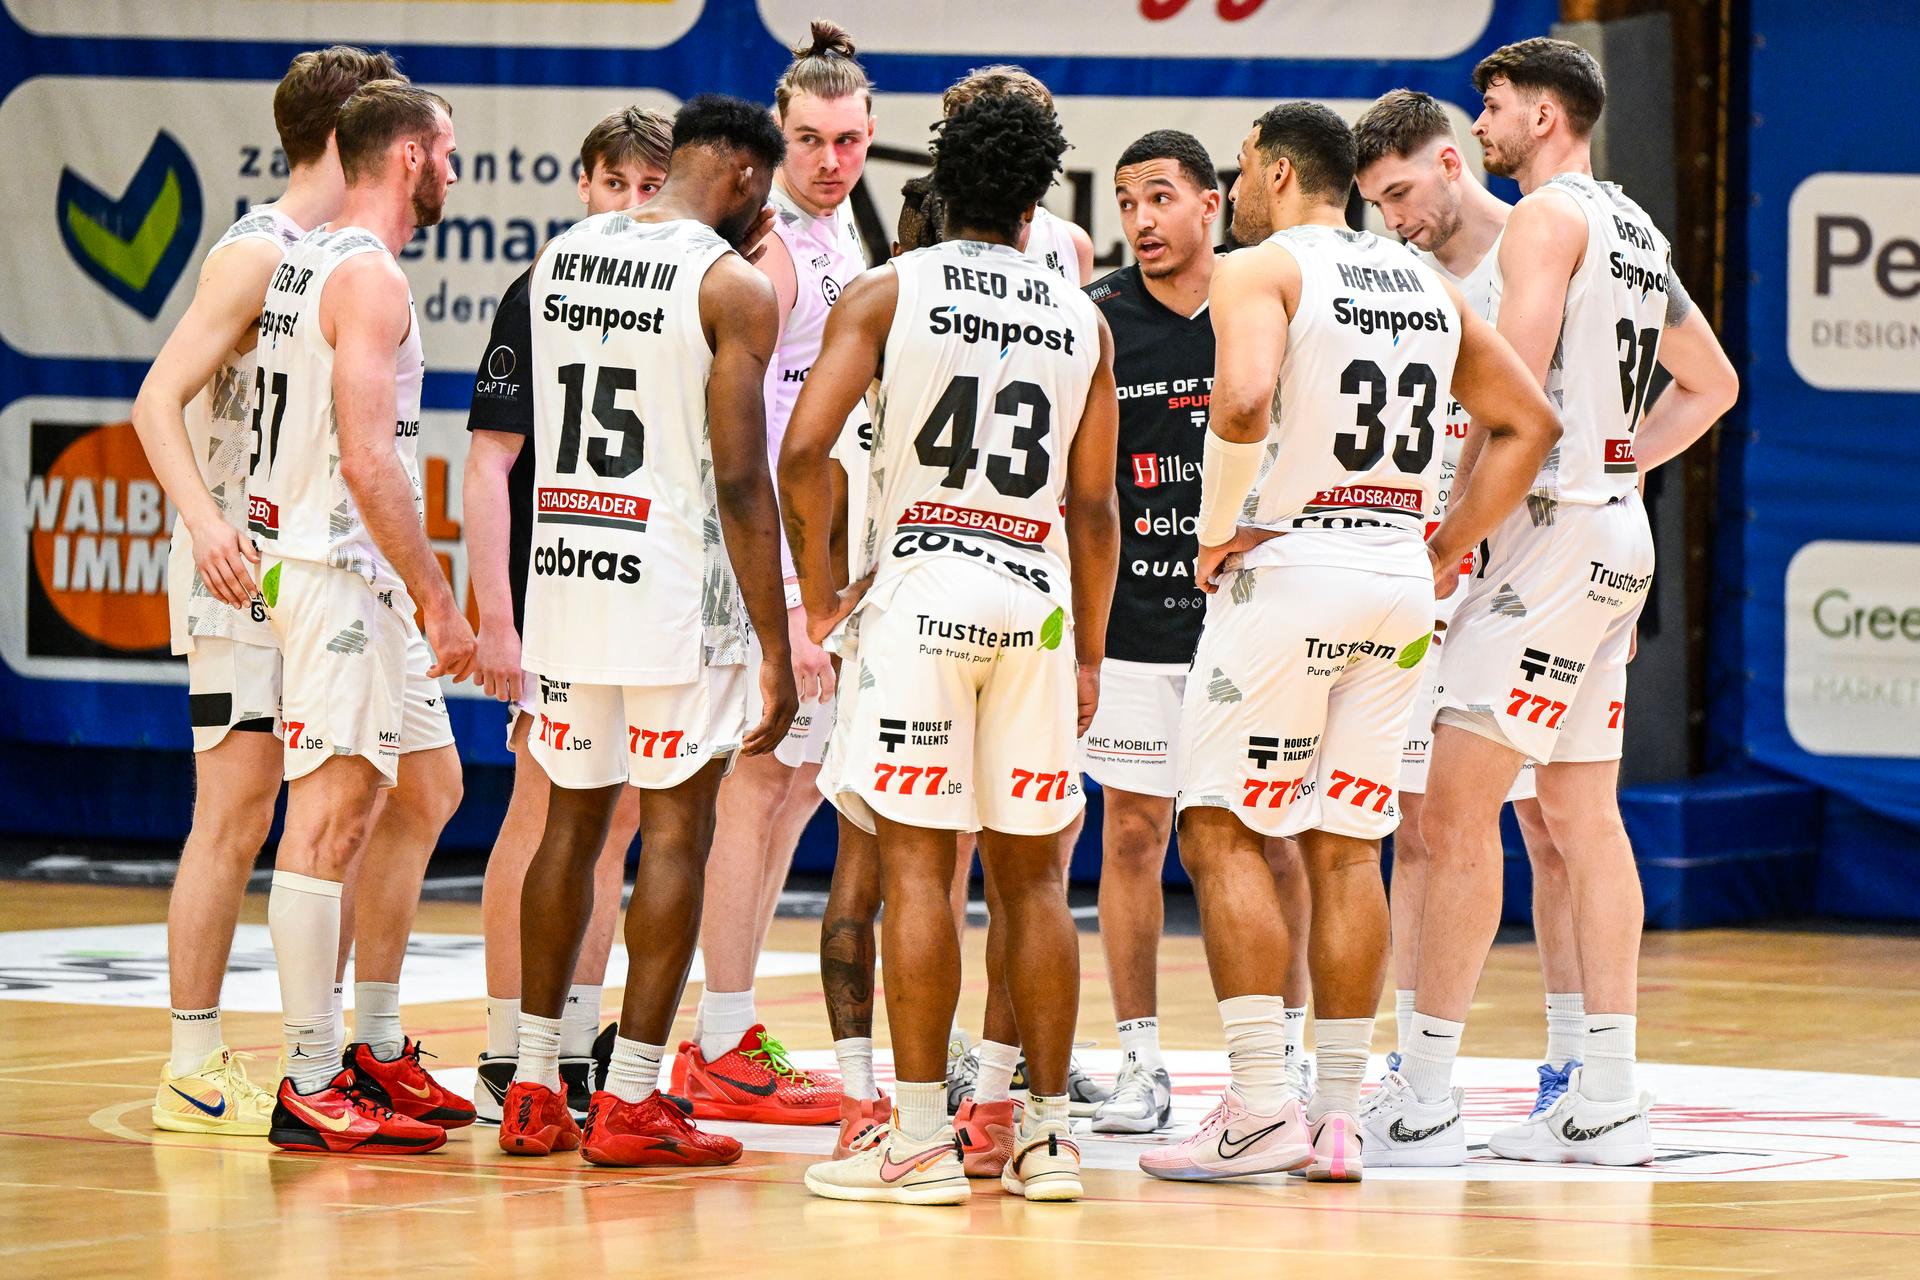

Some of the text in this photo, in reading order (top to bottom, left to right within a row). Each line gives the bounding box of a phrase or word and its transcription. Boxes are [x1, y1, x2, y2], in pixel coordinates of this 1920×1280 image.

[552, 253, 678, 291] NEWMAN III
[1815, 215, 1920, 299] Pe
[943, 265, 1007, 299] REED
[1017, 278, 1059, 308] JR.
[1336, 262, 1425, 292] HOFMAN
[543, 294, 665, 343] Signpost
[929, 305, 1075, 360] Signpost
[1333, 297, 1449, 346] Signpost
[477, 381, 520, 395] CAPTIF
[1172, 378, 1199, 393] OF
[556, 363, 645, 479] 15
[1333, 359, 1437, 474] 33
[914, 375, 1051, 499] 43
[541, 490, 637, 516] STADSBADER
[1320, 488, 1418, 509] STADSBADER
[908, 504, 1040, 540] STADSBADER
[534, 537, 642, 584] cobras
[916, 614, 1033, 648] Trustteam
[919, 644, 943, 656] Pure
[1553, 656, 1577, 671] HOUSE
[1549, 668, 1578, 685] TALENTS
[911, 735, 949, 746] TALENTS
[912, 721, 942, 732] HOUSE
[1087, 736, 1168, 751] MHC MOBILITY
[1284, 737, 1312, 748] HOUSE
[873, 762, 962, 796] 777.be
